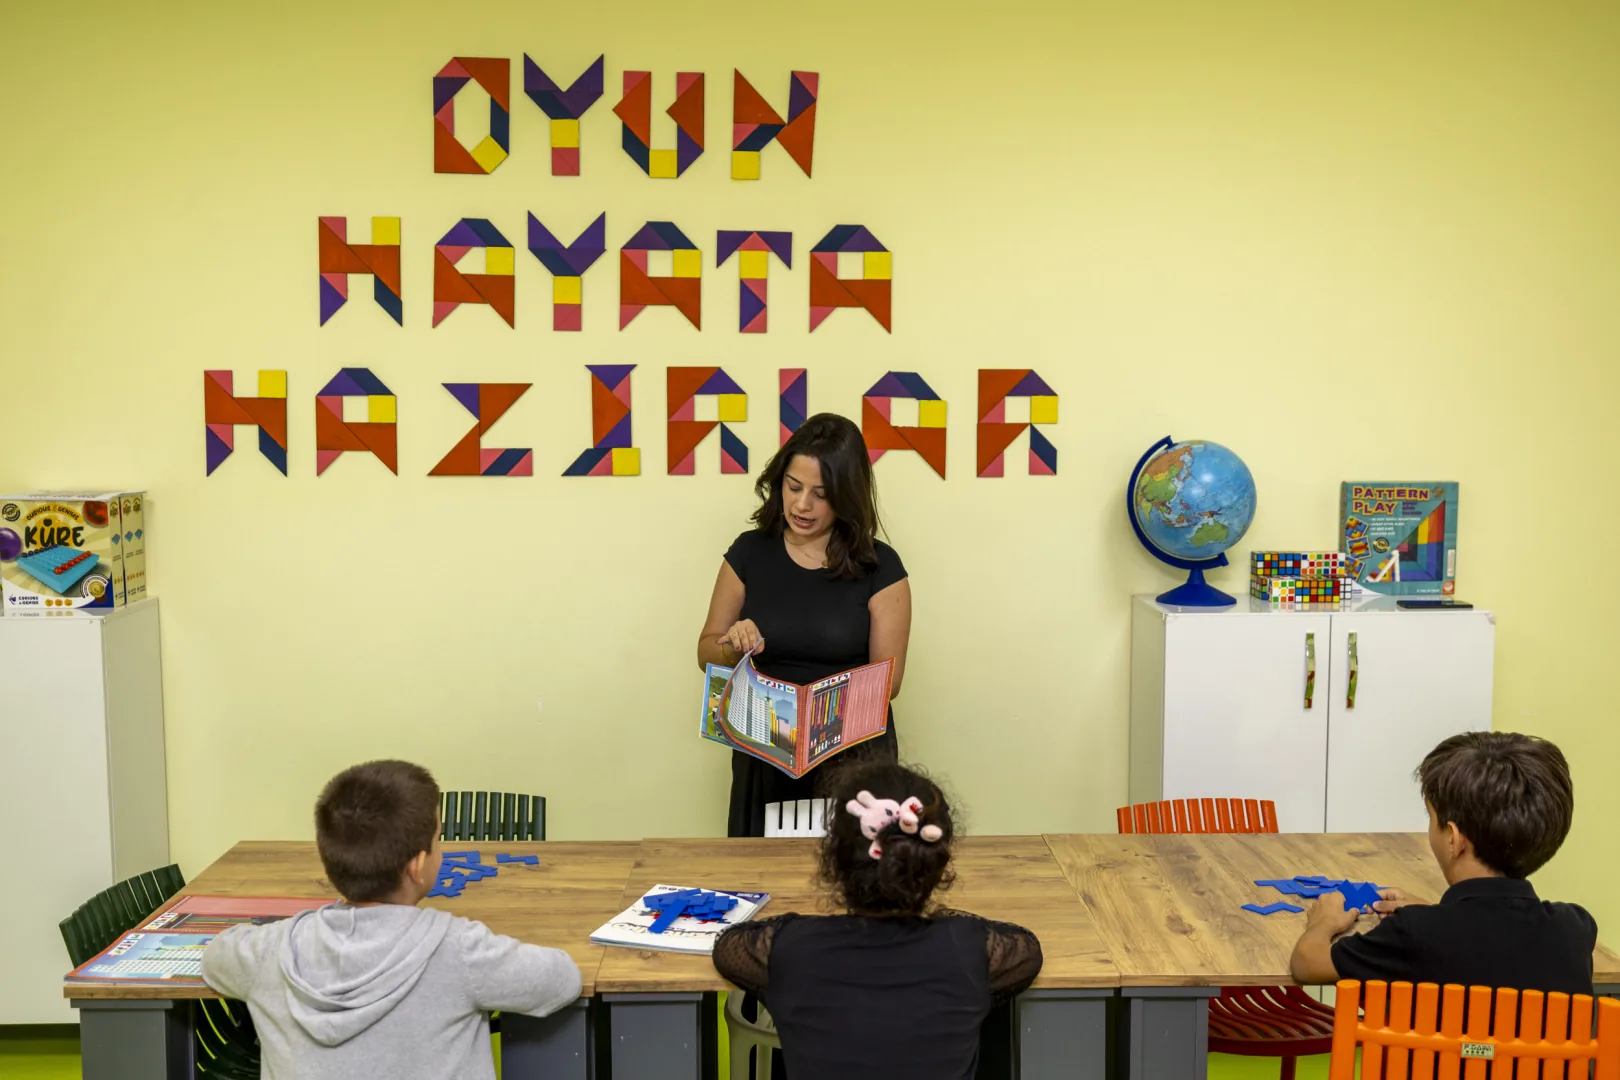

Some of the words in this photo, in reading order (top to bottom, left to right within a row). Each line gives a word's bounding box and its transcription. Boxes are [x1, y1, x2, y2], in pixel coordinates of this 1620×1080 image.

[432, 53, 819, 180] OYUN
[318, 210, 892, 334] HAYATA
[1352, 486, 1430, 500] PATTERN
[26, 505, 51, 521] CURIOUS
[58, 506, 80, 521] GENIUS
[1352, 501, 1398, 516] PLAY
[25, 518, 85, 548] KÜRE
